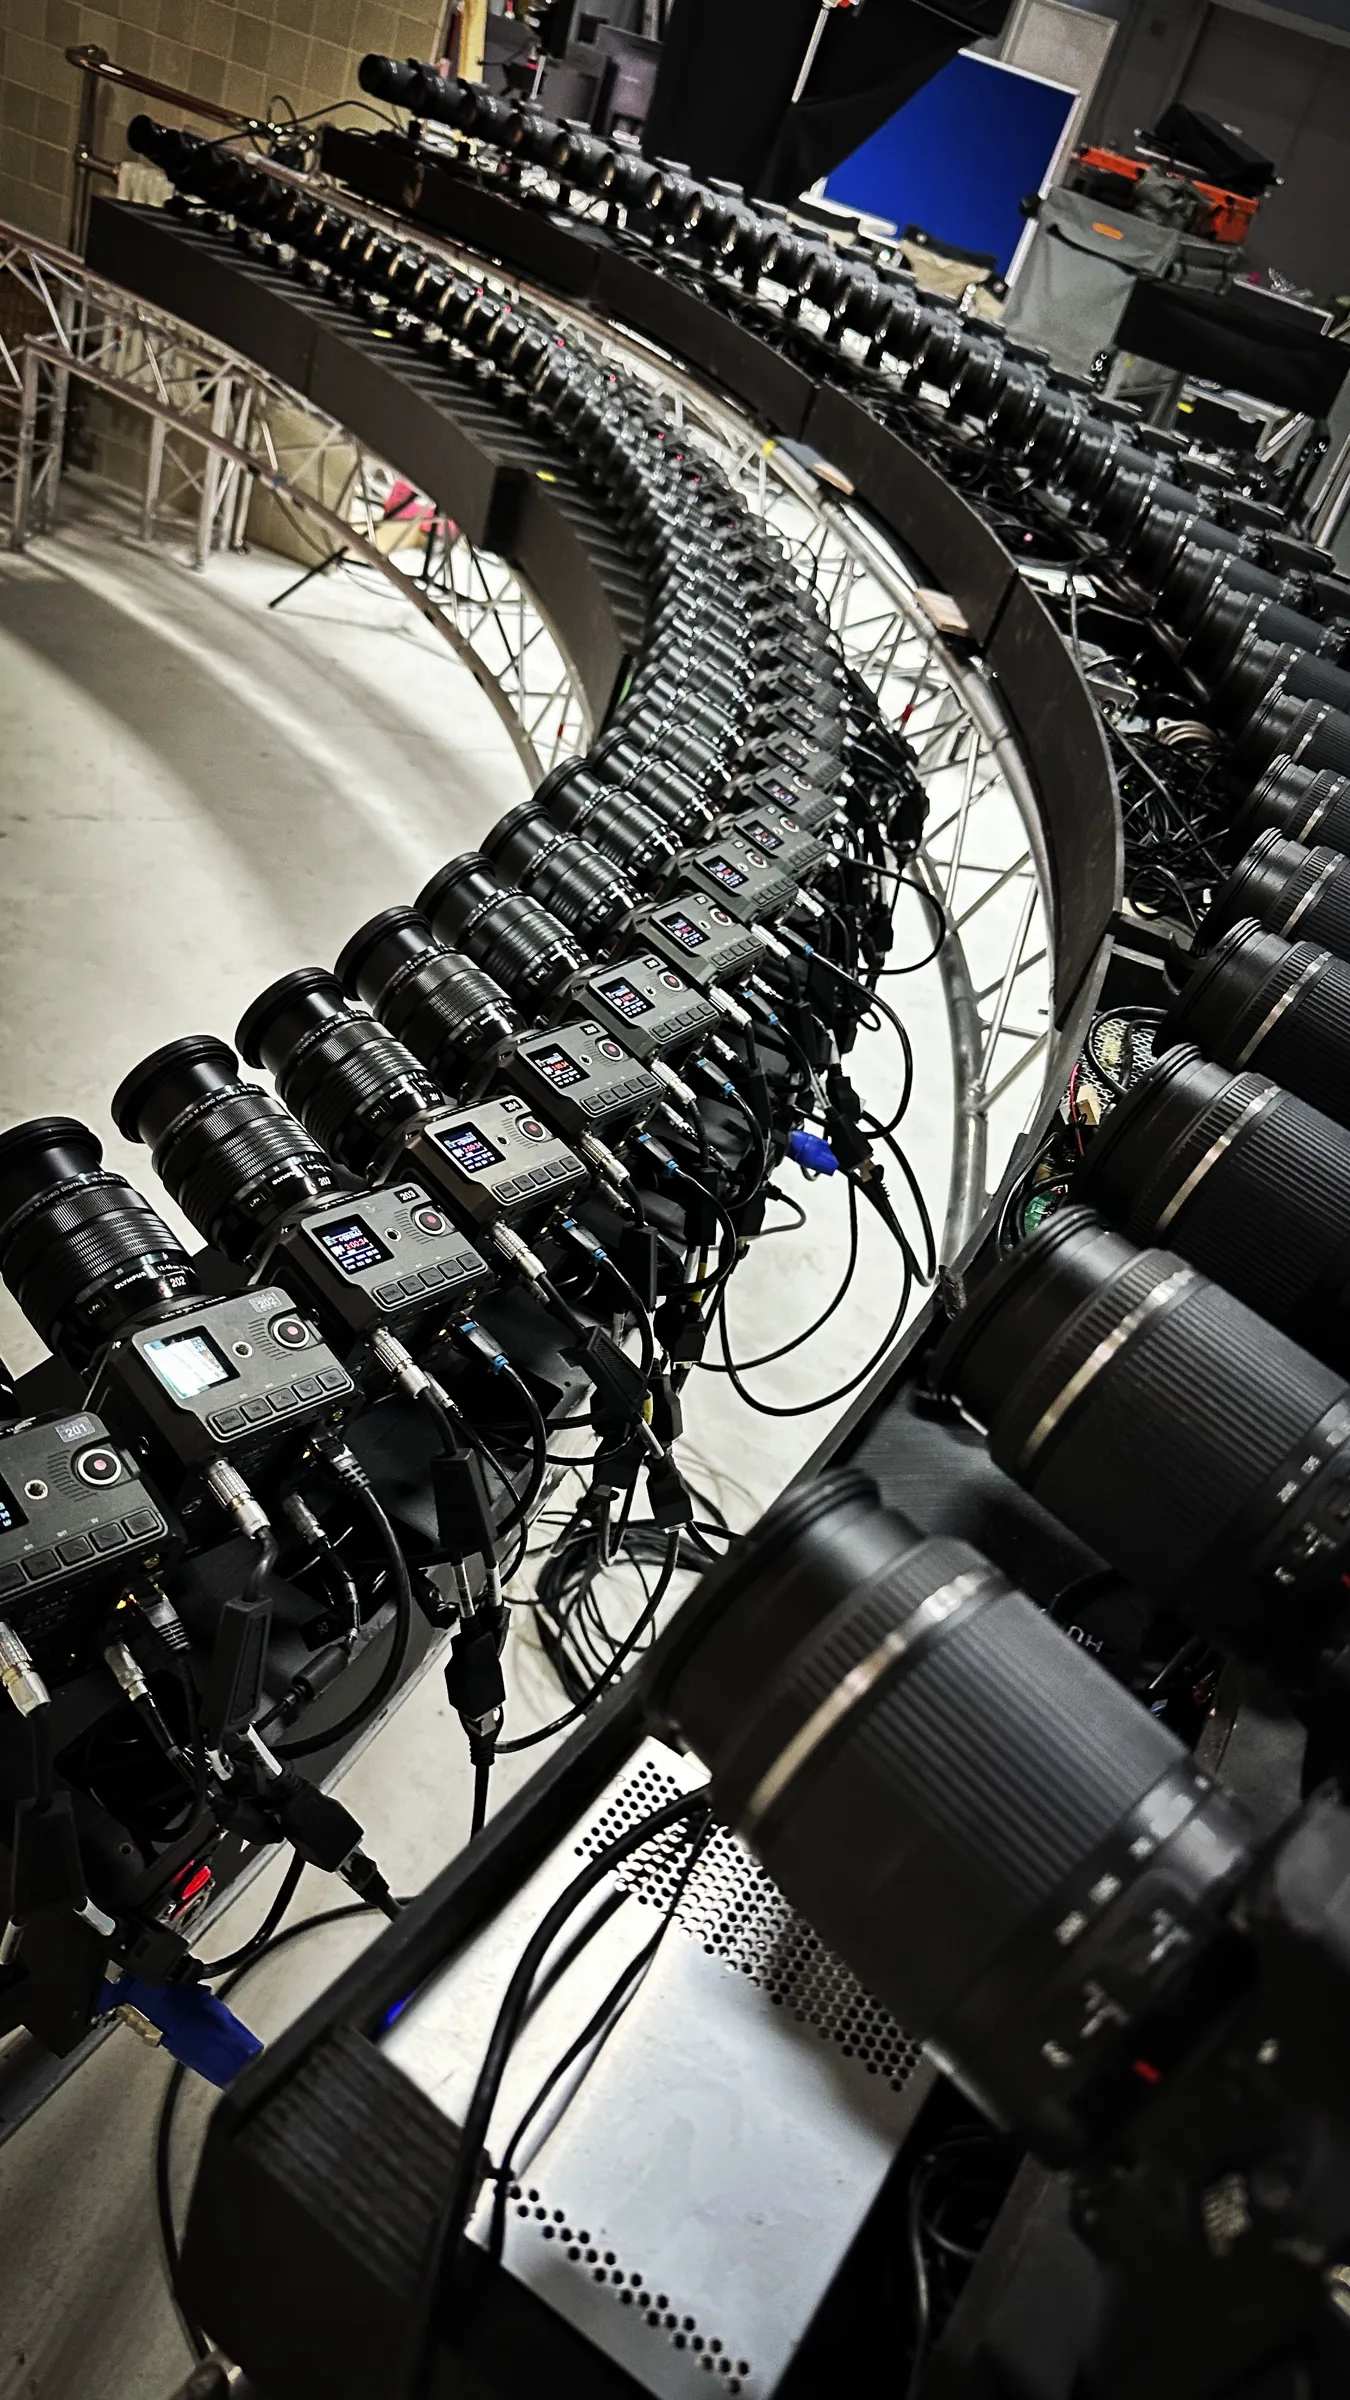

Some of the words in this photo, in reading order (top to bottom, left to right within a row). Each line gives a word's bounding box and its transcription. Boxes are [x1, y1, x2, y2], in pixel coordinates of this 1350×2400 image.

[399, 1190, 417, 1201] 203
[114, 1271, 147, 1290] OLYMPUS
[169, 1275, 187, 1288] 202
[257, 1296, 278, 1310] 202
[65, 1423, 88, 1438] 201
